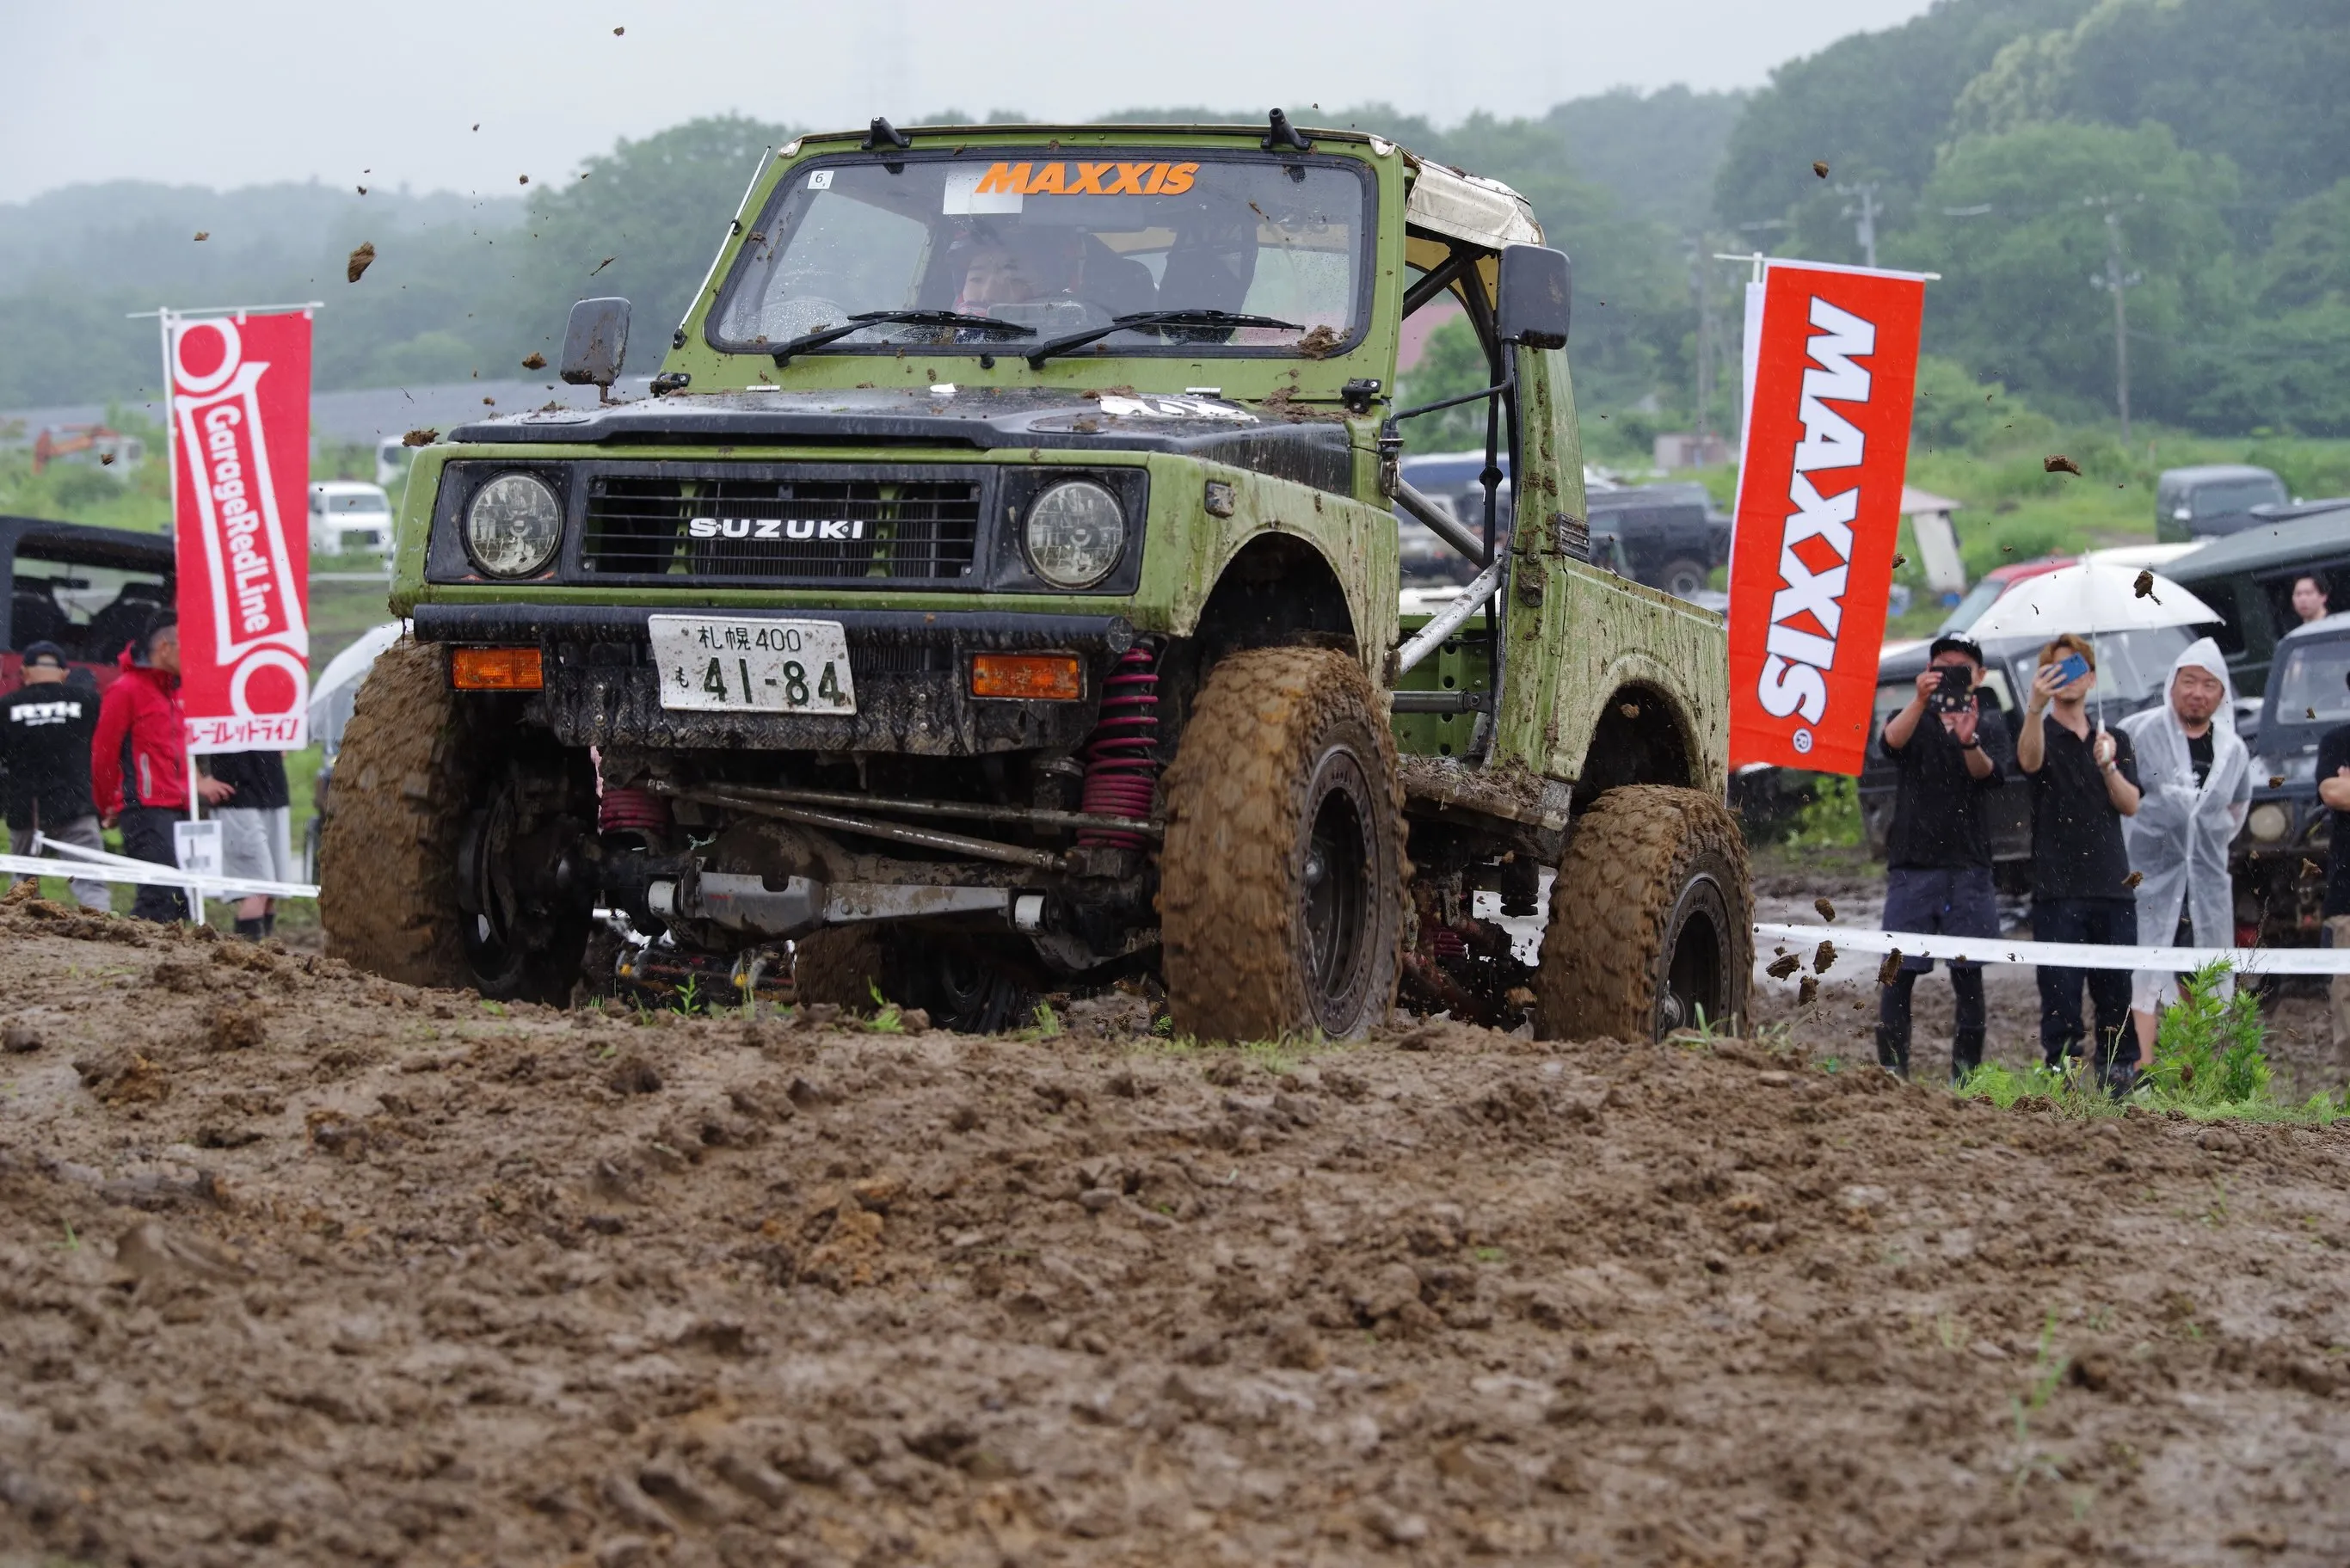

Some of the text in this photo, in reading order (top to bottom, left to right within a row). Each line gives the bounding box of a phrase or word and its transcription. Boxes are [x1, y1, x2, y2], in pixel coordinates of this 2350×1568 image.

[815, 173, 824, 183] 6
[975, 162, 1201, 196] MAXXIS
[204, 404, 272, 634] GarageRedLine
[689, 518, 864, 539] SUZUKI
[1756, 294, 1877, 727] MAXXIS
[703, 656, 846, 708] 41-84
